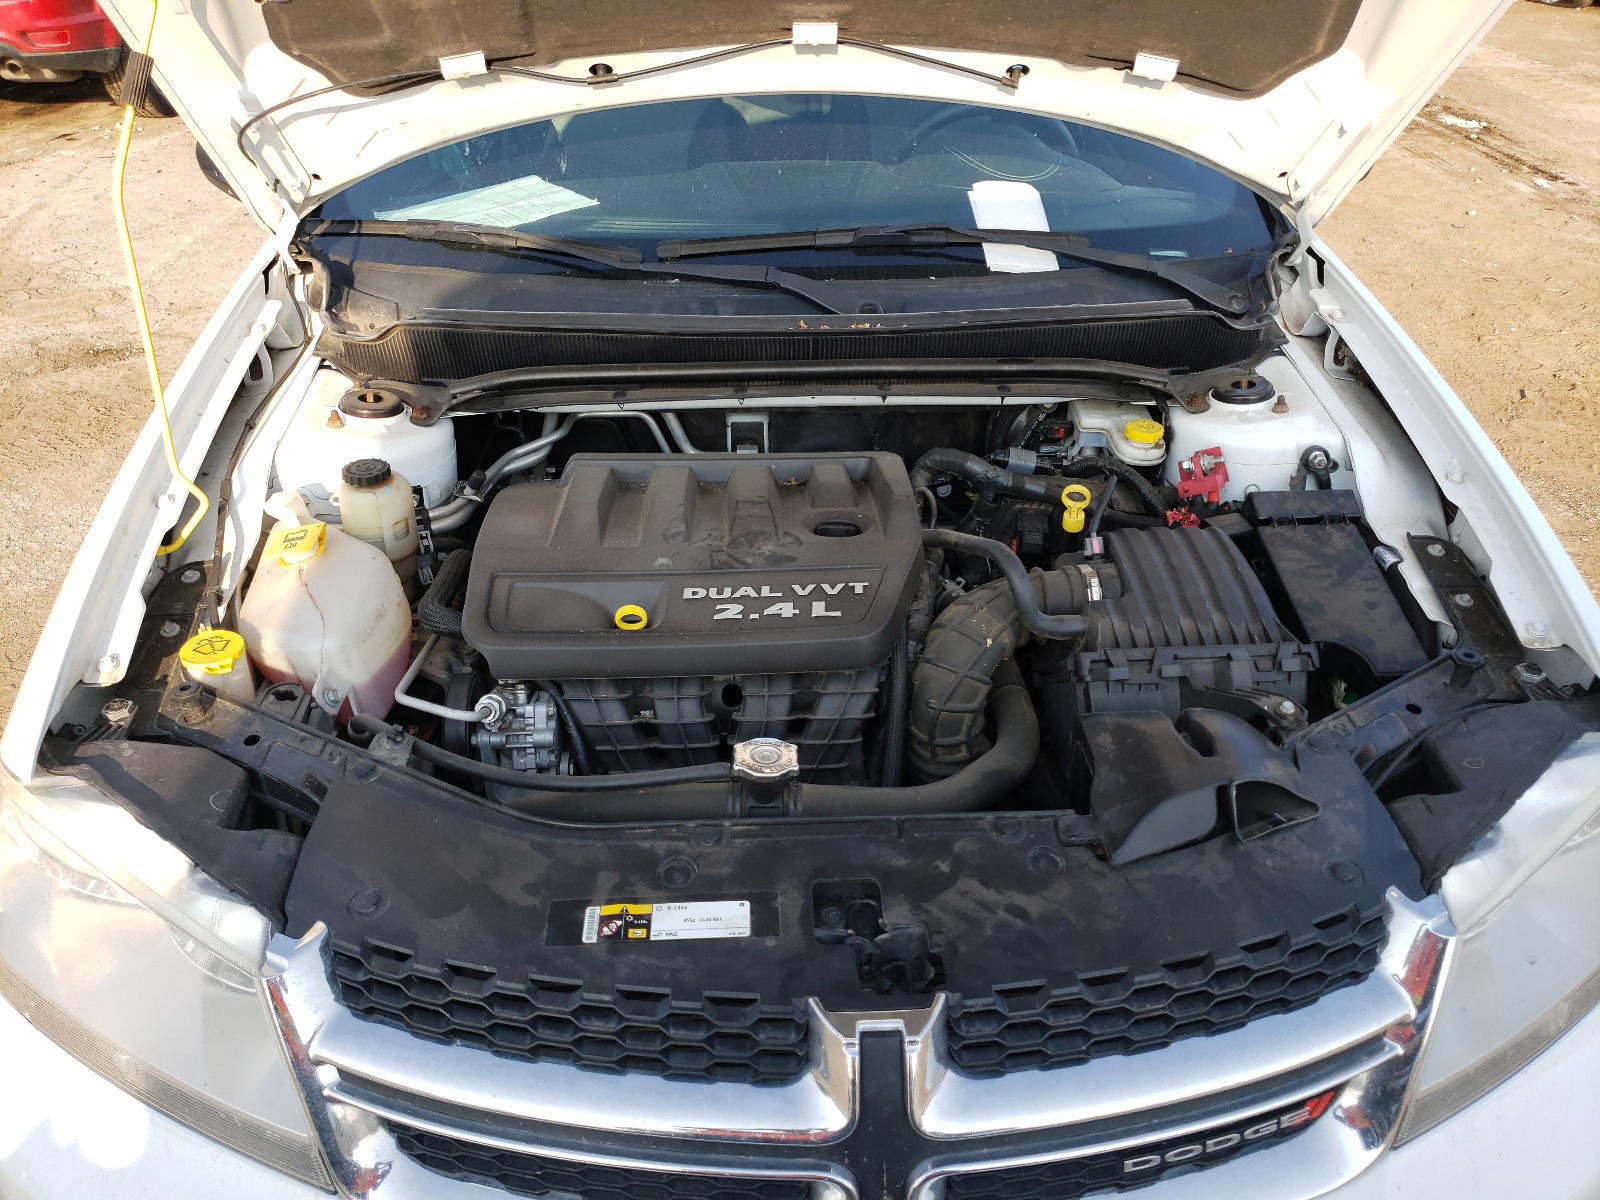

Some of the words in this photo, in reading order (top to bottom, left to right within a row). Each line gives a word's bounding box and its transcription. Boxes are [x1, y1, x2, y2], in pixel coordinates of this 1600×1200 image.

[682, 586, 782, 599] DUAL
[791, 582, 869, 595] VVT
[713, 601, 800, 620] 2.4
[811, 601, 842, 617] L
[1123, 1106, 1310, 1173] DODGE
